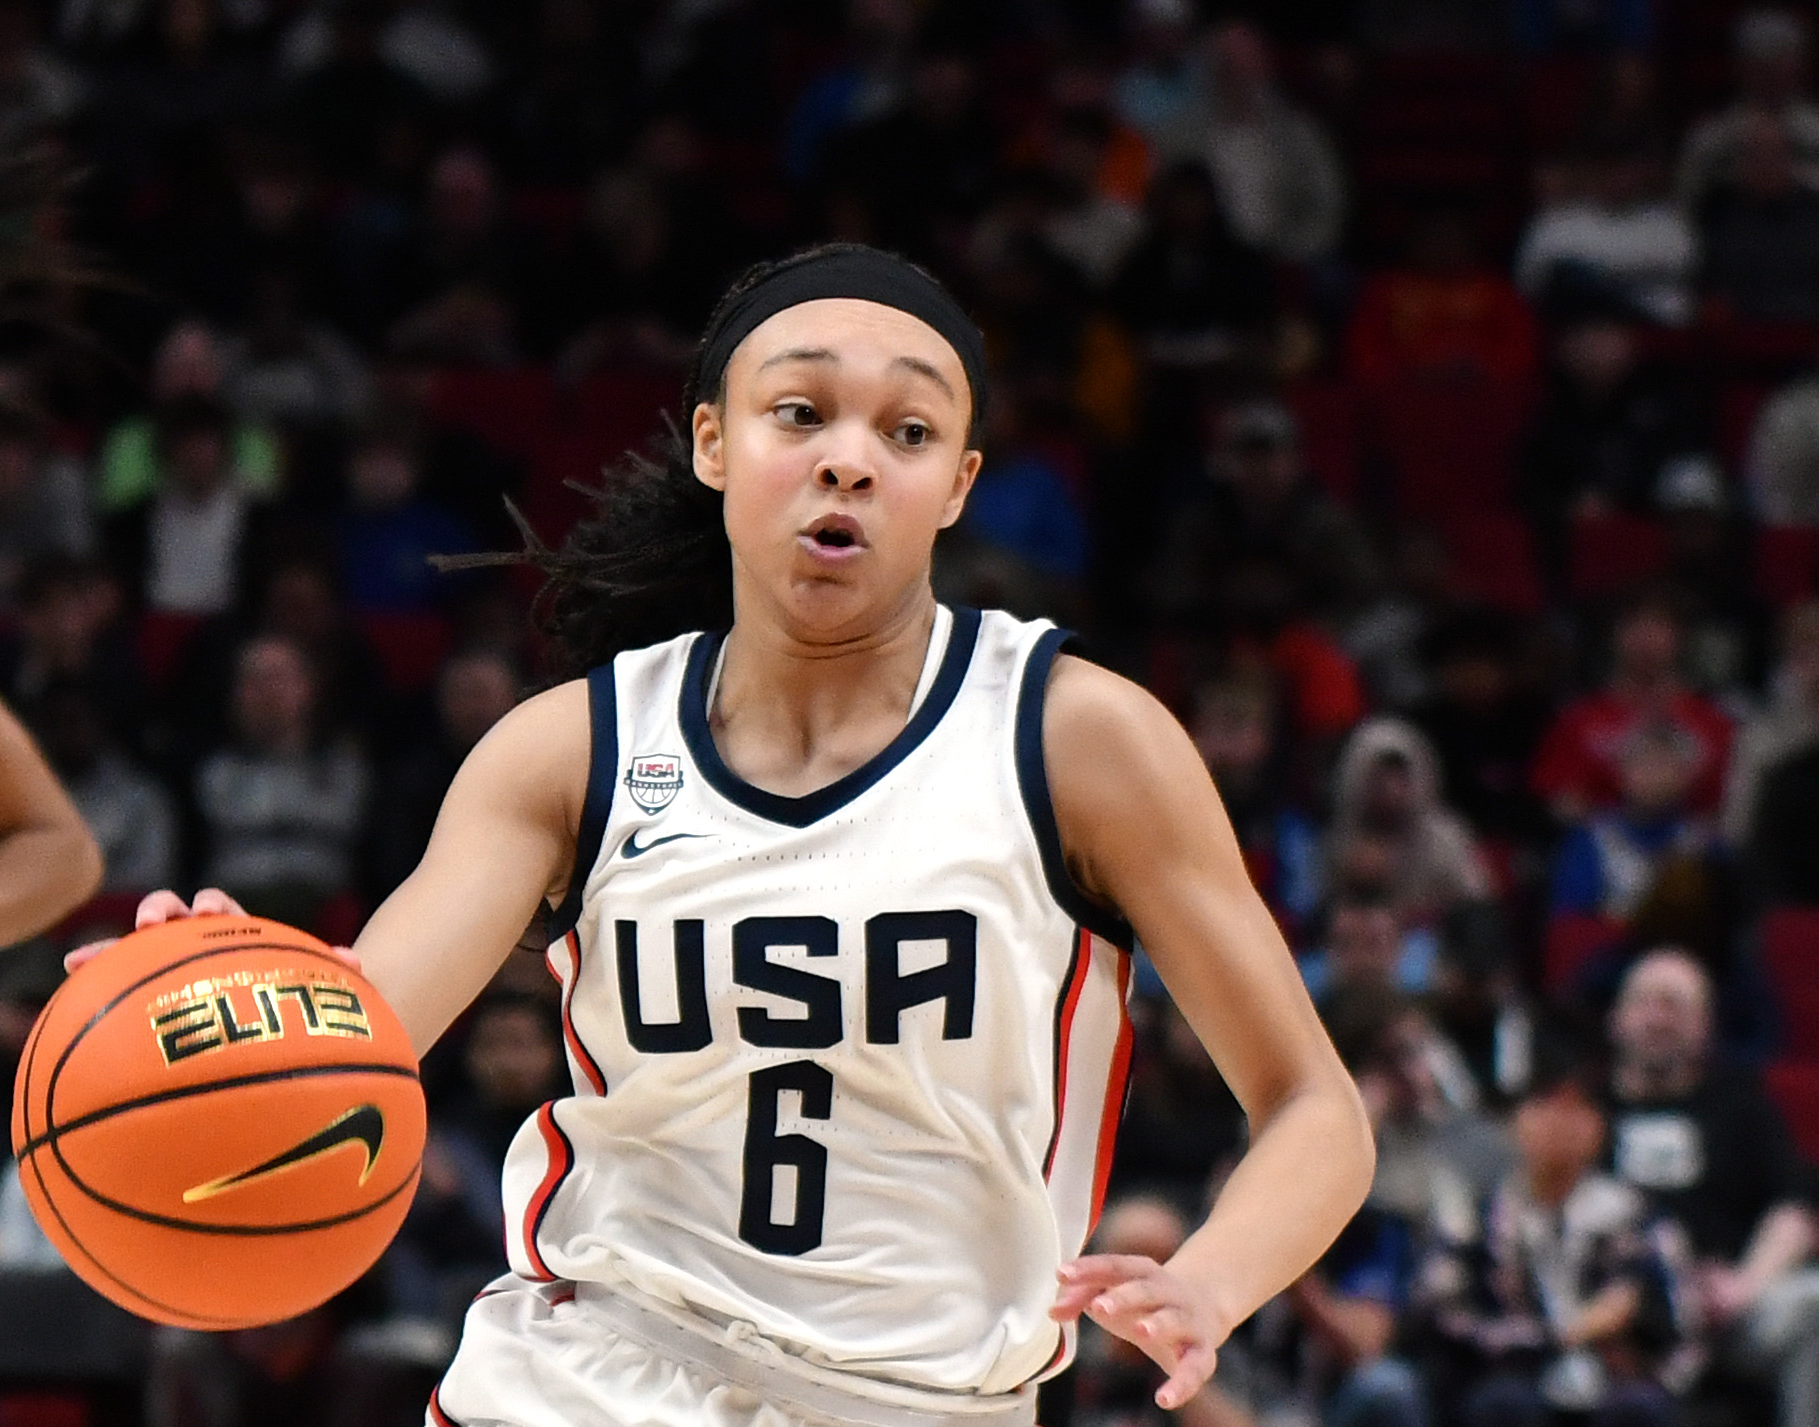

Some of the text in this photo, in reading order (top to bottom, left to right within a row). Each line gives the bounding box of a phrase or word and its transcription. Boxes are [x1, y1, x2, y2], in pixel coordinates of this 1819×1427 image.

[638, 763, 675, 778] USA
[614, 909, 978, 1054] USA
[738, 1059, 834, 1257] 6
